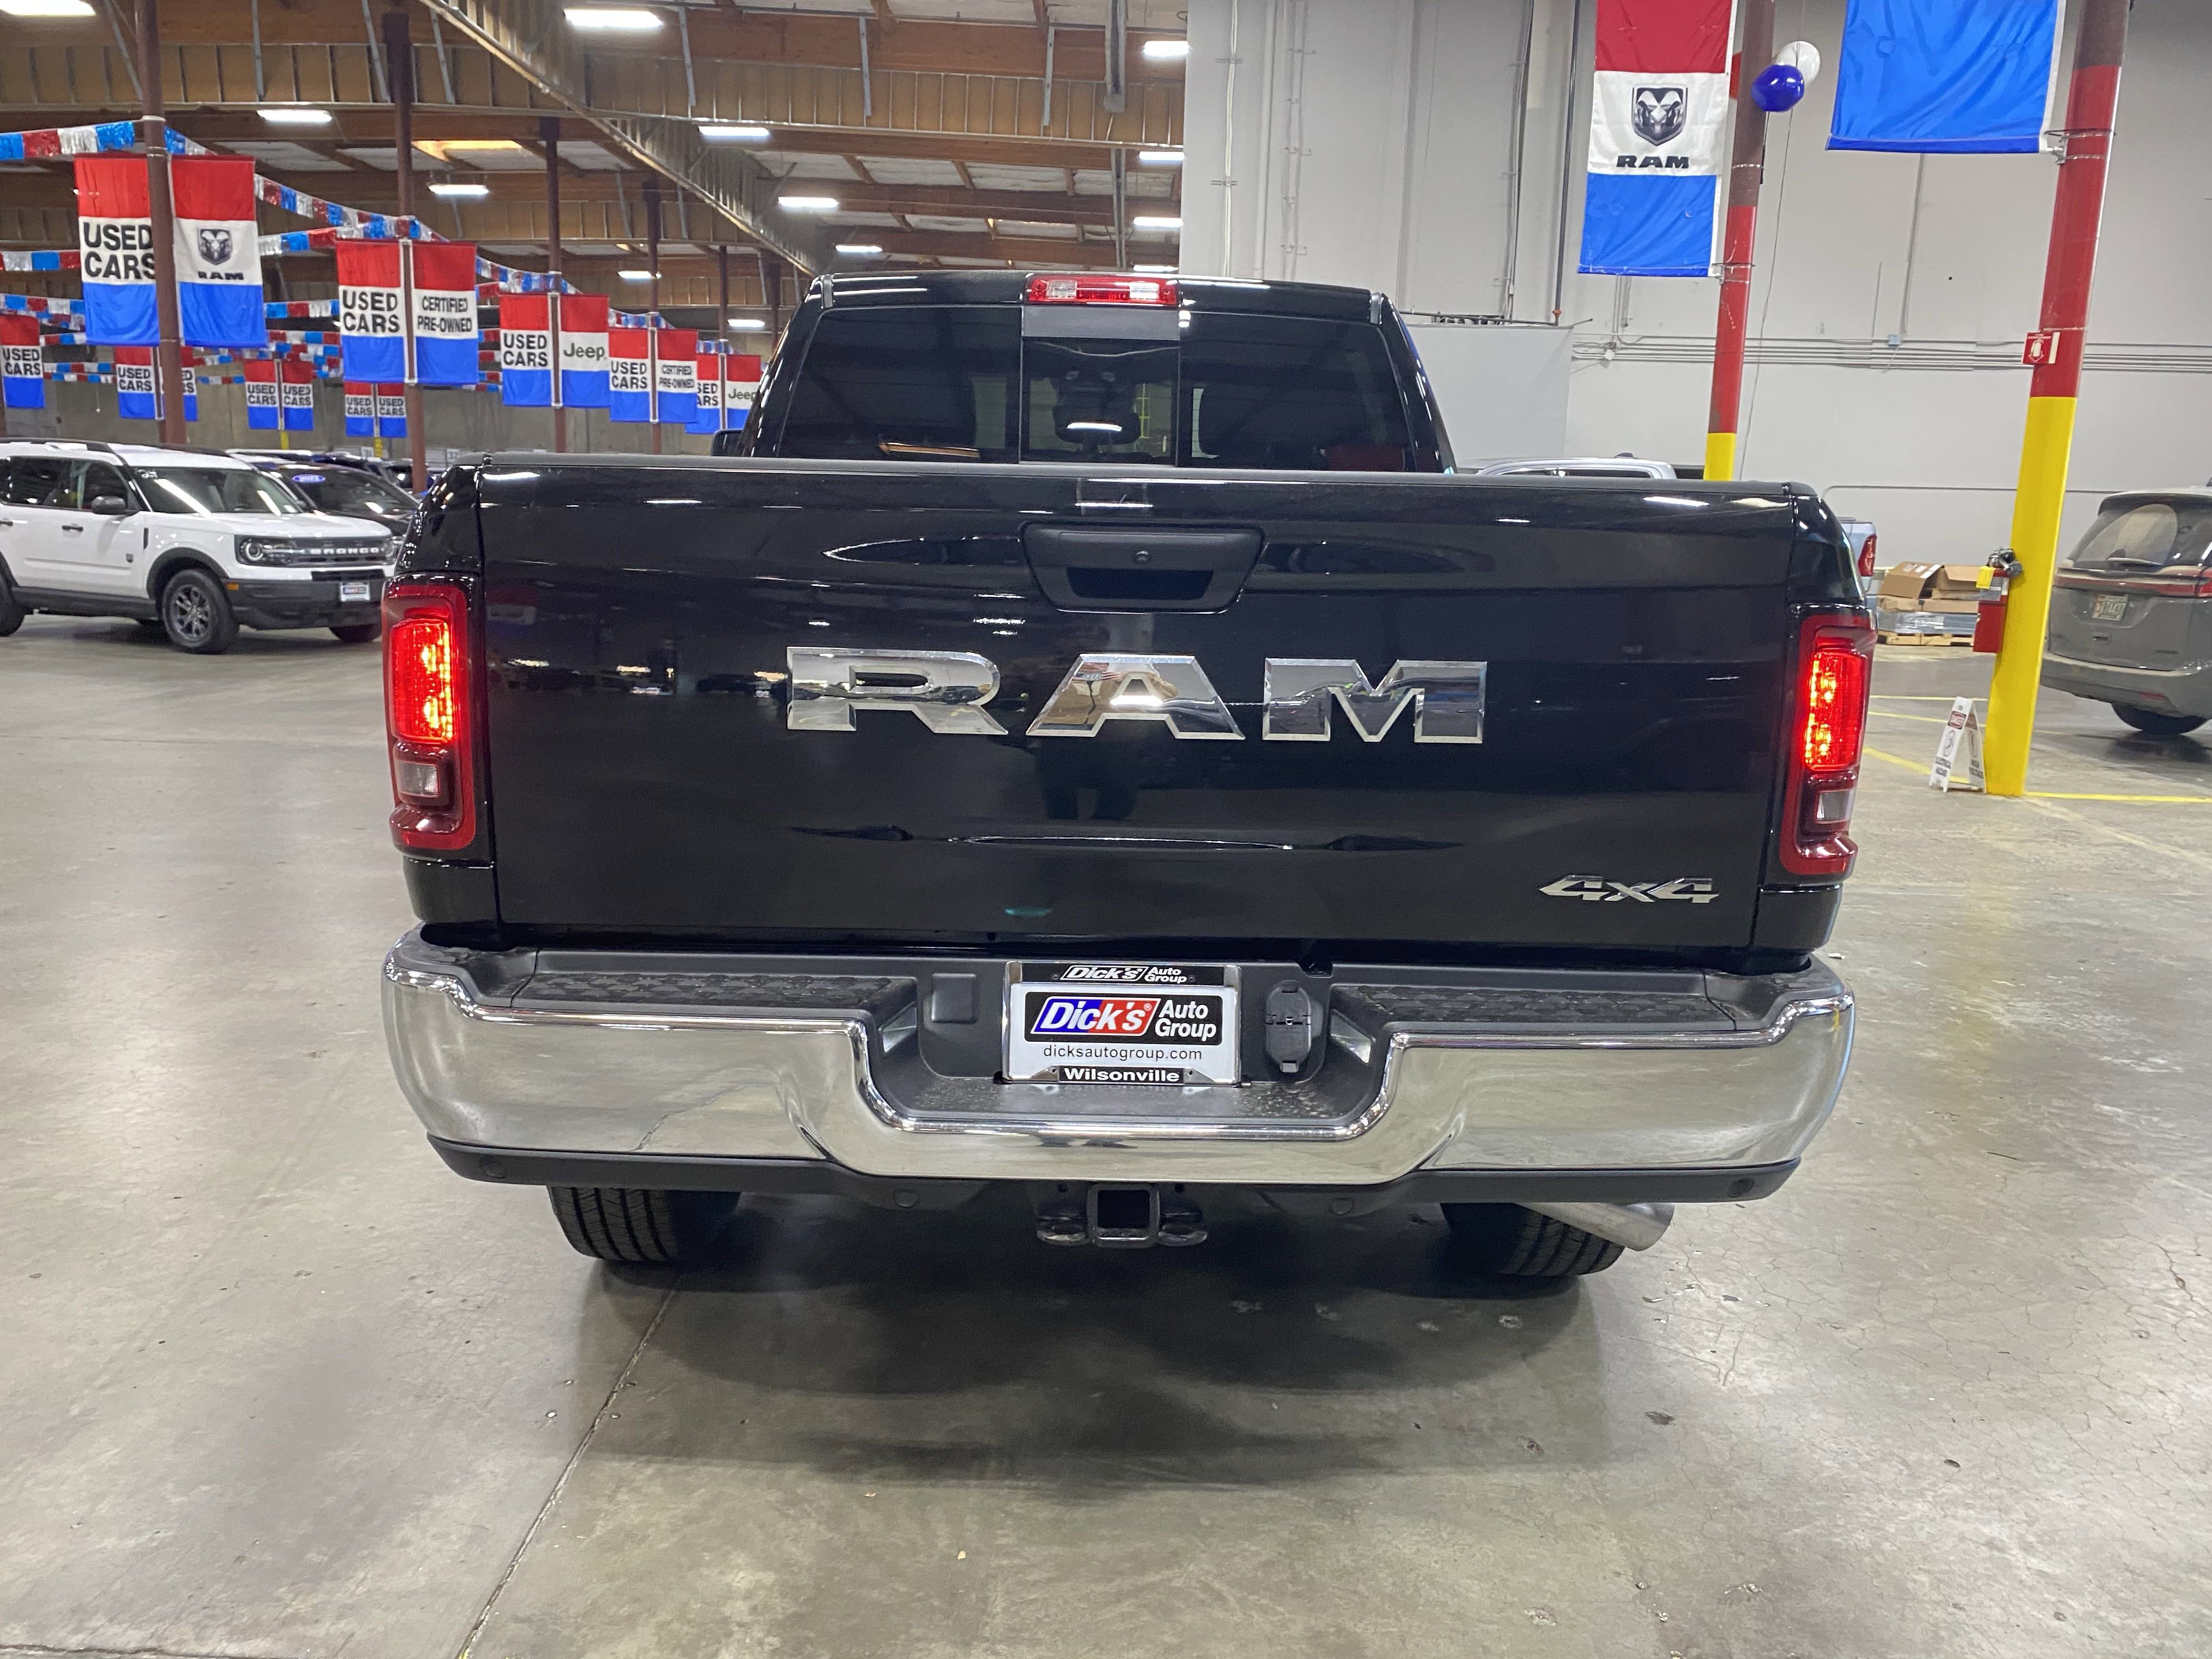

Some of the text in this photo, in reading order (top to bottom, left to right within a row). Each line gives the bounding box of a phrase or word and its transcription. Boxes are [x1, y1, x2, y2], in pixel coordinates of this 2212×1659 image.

[1616, 155, 1689, 169] RAM
[83, 222, 152, 250] USED
[84, 251, 155, 279] CARS
[198, 271, 245, 280] RAM
[342, 290, 398, 312] USED
[421, 295, 468, 313] CERTIFIED
[343, 312, 400, 333] CARS
[417, 315, 472, 332] PRE-OWNED
[504, 332, 547, 350] USED
[3, 347, 40, 362] USED
[503, 350, 548, 367] CARS
[563, 342, 606, 361] Jeep
[5, 362, 41, 376] CARS
[117, 366, 150, 379] USED
[611, 361, 647, 375] USED
[119, 379, 153, 392] CARS
[247, 385, 275, 394] USED
[612, 375, 647, 390] CARS
[697, 382, 718, 394] SED
[283, 385, 311, 395] USED
[248, 394, 276, 405] CARS
[284, 395, 312, 406] CARS
[346, 397, 371, 406] USED
[379, 397, 404, 407] USED
[697, 395, 719, 407] ARS
[347, 407, 373, 415] CARS
[379, 407, 404, 416] CARS
[786, 646, 1487, 743] RAM
[1066, 967, 1182, 980] Dick's Auto
[1144, 975, 1187, 984] Group
[1040, 1000, 1208, 1031] Dick's Auto
[1154, 1018, 1217, 1041] Group
[1043, 1043, 1203, 1062] dicksautogroup.com
[1063, 1068, 1180, 1083] Wilsonville
